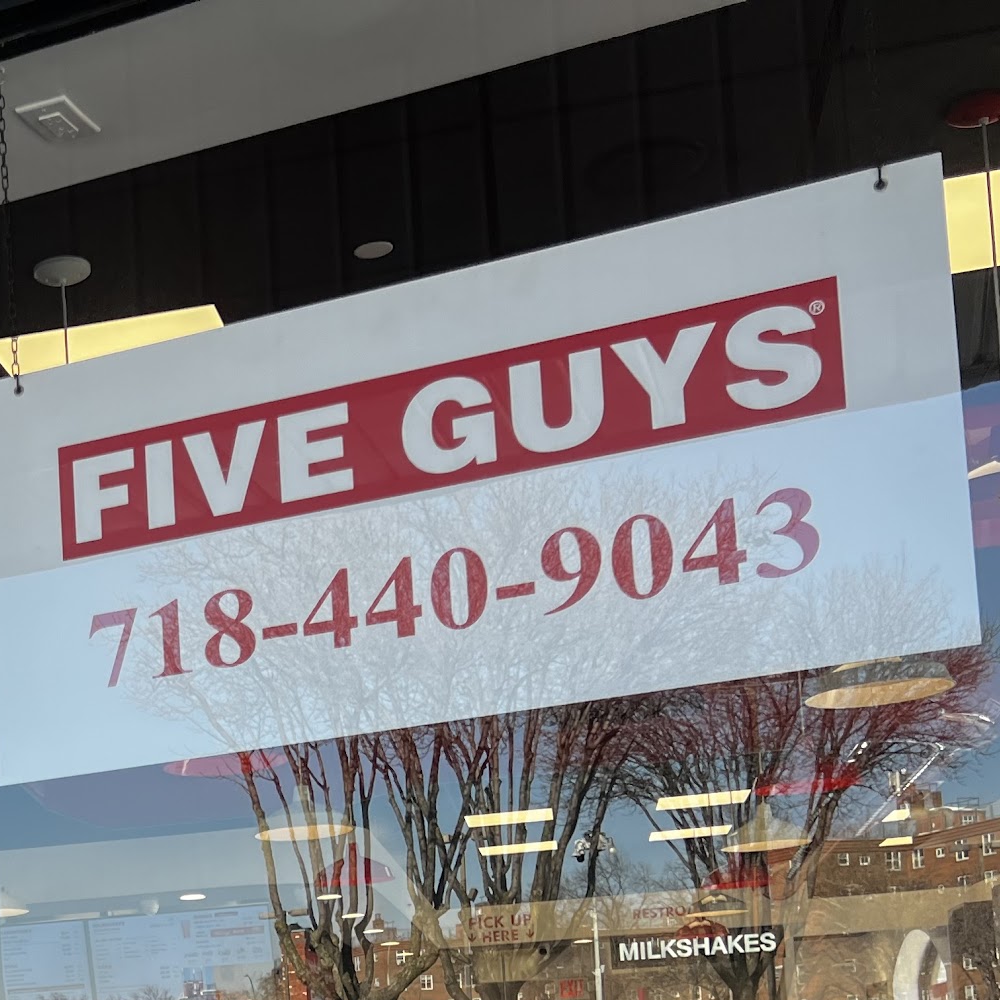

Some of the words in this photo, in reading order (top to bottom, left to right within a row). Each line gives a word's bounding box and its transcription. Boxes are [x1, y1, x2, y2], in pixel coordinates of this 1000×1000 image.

[72, 402, 355, 544] FIVE
[402, 304, 824, 476] GUYS
[88, 487, 821, 689] 718-440-9043
[468, 915, 504, 930] PICK
[510, 914, 533, 927] UP
[632, 904, 692, 920] RESTRO
[482, 929, 519, 943] HERE
[618, 931, 777, 963] MILKSHAKES
[559, 978, 585, 998] EXIT
